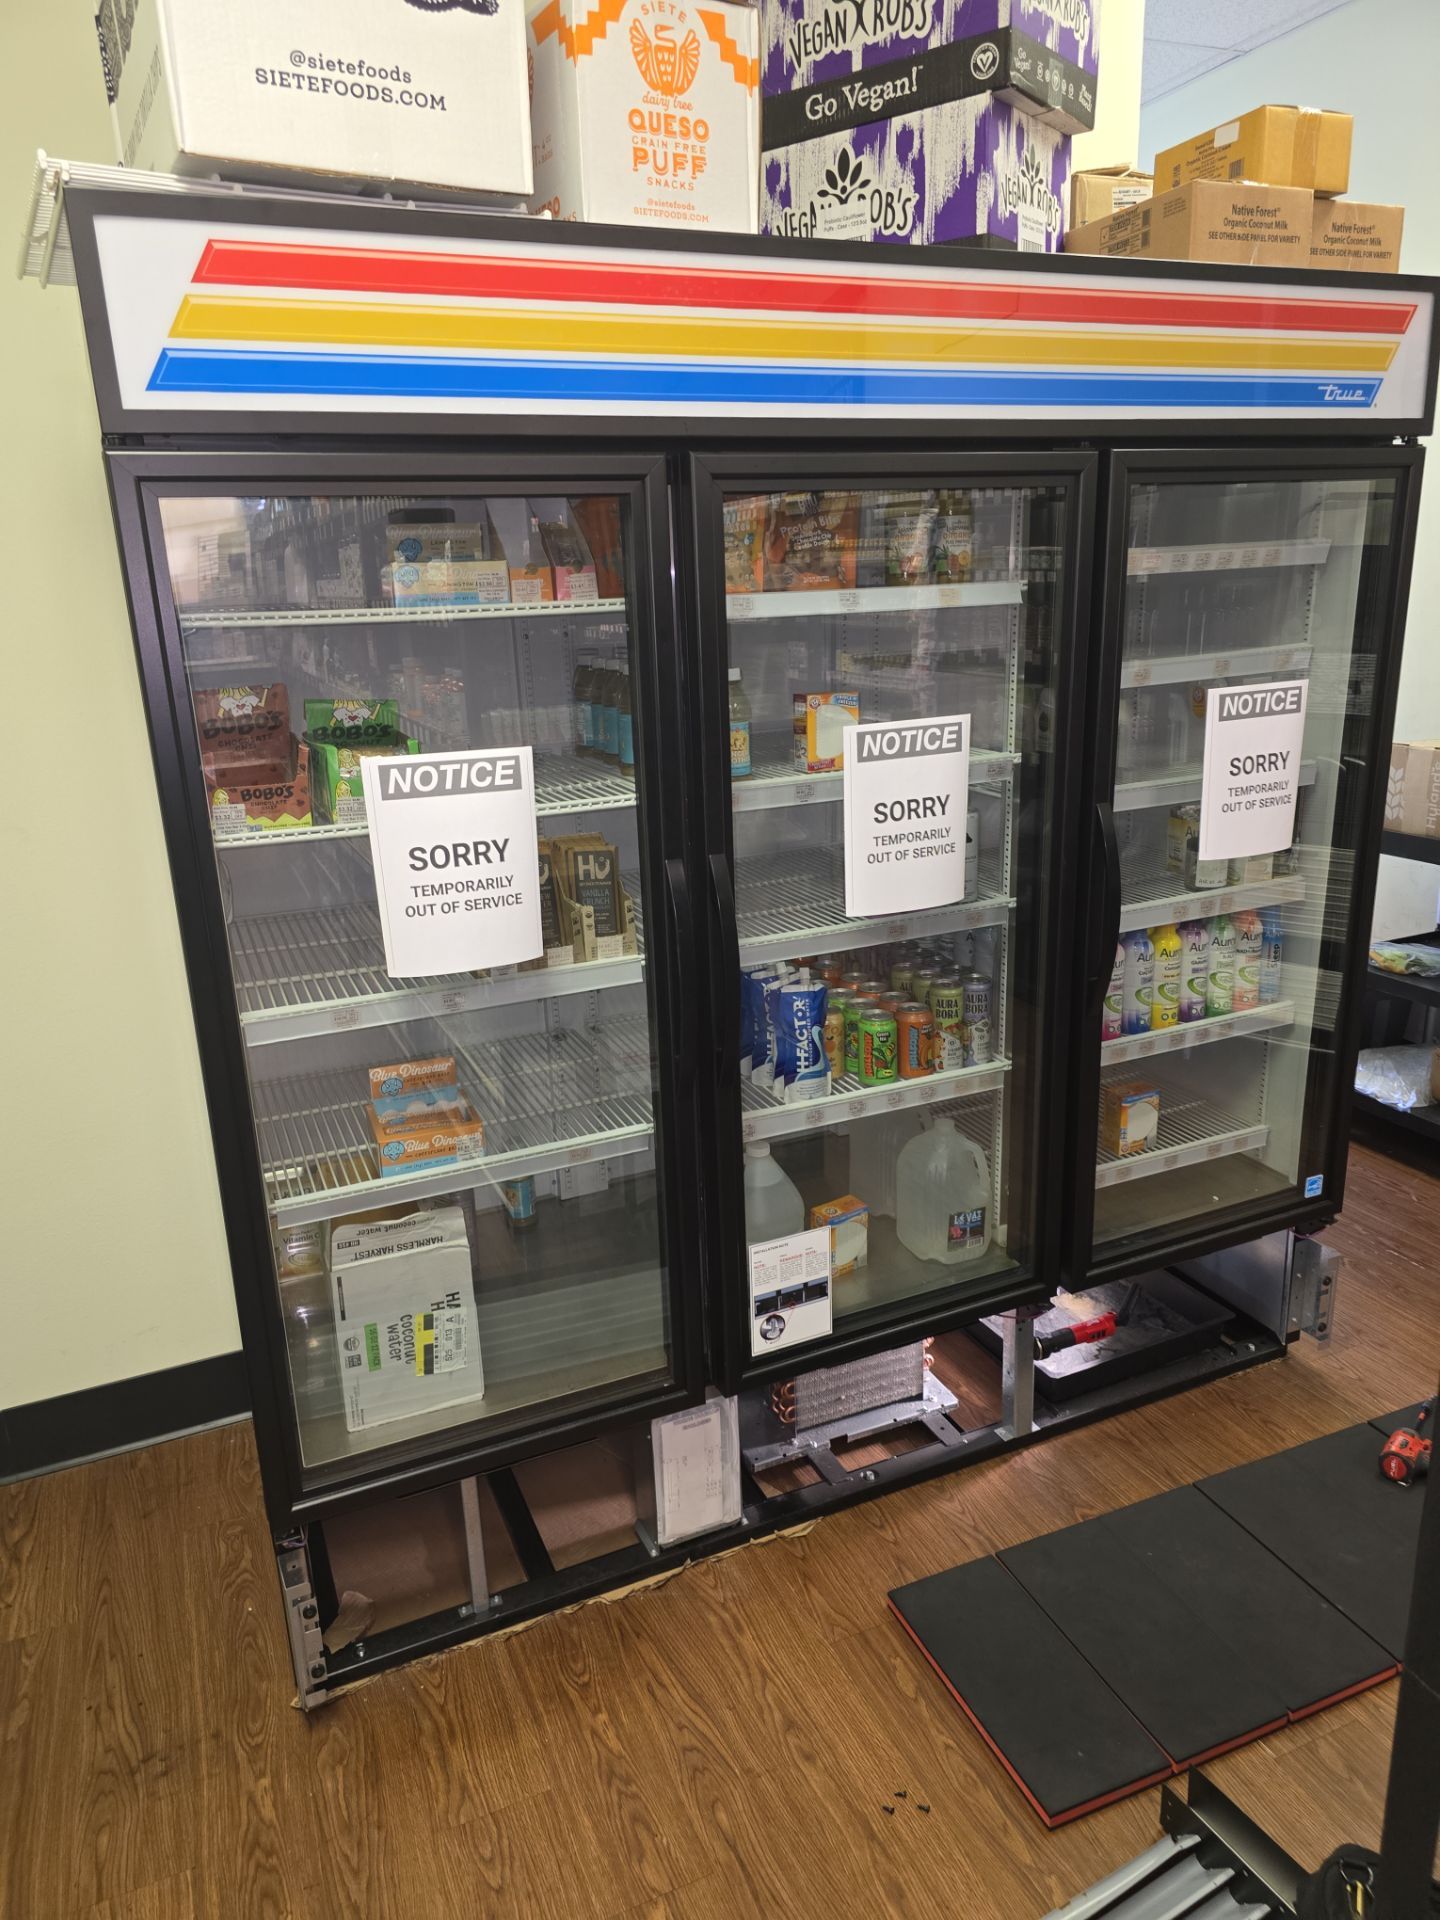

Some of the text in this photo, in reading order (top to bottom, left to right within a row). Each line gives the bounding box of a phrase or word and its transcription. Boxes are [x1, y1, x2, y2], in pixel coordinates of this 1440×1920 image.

[641, 1, 687, 23] SIETE
[790, 0, 848, 68] VEGAN
[1017, 47, 1027, 59] Go
[289, 50, 412, 84] @sietefoods
[255, 67, 447, 111] SIETEFOODS.COM
[642, 91, 694, 112] dairy free
[805, 94, 838, 121] Go
[628, 108, 710, 143] QUESO
[631, 136, 706, 155] GRAIN FREE
[632, 147, 707, 180] PUFF
[647, 177, 695, 191] SNACKS
[647, 198, 696, 211] @sietefoods
[857, 187, 912, 231] OB'S
[1232, 204, 1255, 217] Native
[633, 206, 710, 224] SIETEFOODS.COM
[1223, 217, 1288, 231] Organic Coconut Milk
[1208, 231, 1219, 240] SEE
[1219, 231, 1237, 241] OTHER
[1267, 234, 1279, 243] FOR
[1278, 235, 1300, 244] VARIETY
[1331, 222, 1352, 233] Native
[1323, 234, 1382, 246] Organic Coconut Milk
[1309, 247, 1319, 255] SEE
[1319, 247, 1335, 256] OTHER
[1335, 248, 1347, 257] SIDE
[1362, 250, 1373, 259] FOR
[1373, 251, 1393, 260] VARIETY
[1317, 384, 1366, 401] true
[1223, 689, 1300, 717] NOTICE
[203, 710, 284, 740] BOBO'S
[311, 722, 394, 740] BOBO'S
[217, 733, 273, 749] CHOCOLATE
[862, 726, 959, 758] NOTICE
[1229, 751, 1290, 777] SORRY
[387, 759, 516, 794] NOTICE
[240, 784, 295, 802] BOBO'S
[1227, 780, 1290, 798] TEMPORARILY
[873, 794, 951, 824] SORRY
[1221, 794, 1293, 814] OUT OF SERVICE
[872, 827, 952, 847] TEMPORARILY
[408, 838, 510, 872] SORRY
[867, 842, 956, 865] OUT OF SERVICE
[410, 875, 514, 898] TEMPORARILY
[405, 903, 437, 918] OUT
[440, 901, 461, 914] OF
[464, 892, 523, 912] SERVICE
[936, 999, 959, 1009] AURA
[965, 1003, 989, 1013] BORA
[966, 993, 988, 1003] AURA
[935, 1009, 960, 1019] BORA
[369, 1068, 398, 1083] Blue
[400, 1061, 452, 1078] Dinosaur
[404, 1139, 431, 1153] Blue
[356, 1226, 382, 1237] water
[384, 1219, 416, 1233] coconut
[283, 1233, 314, 1245] Vitamin
[352, 1235, 444, 1262] HARMLESS HARVEST
[386, 1322, 403, 1362] water
[400, 1313, 417, 1365] coconut
